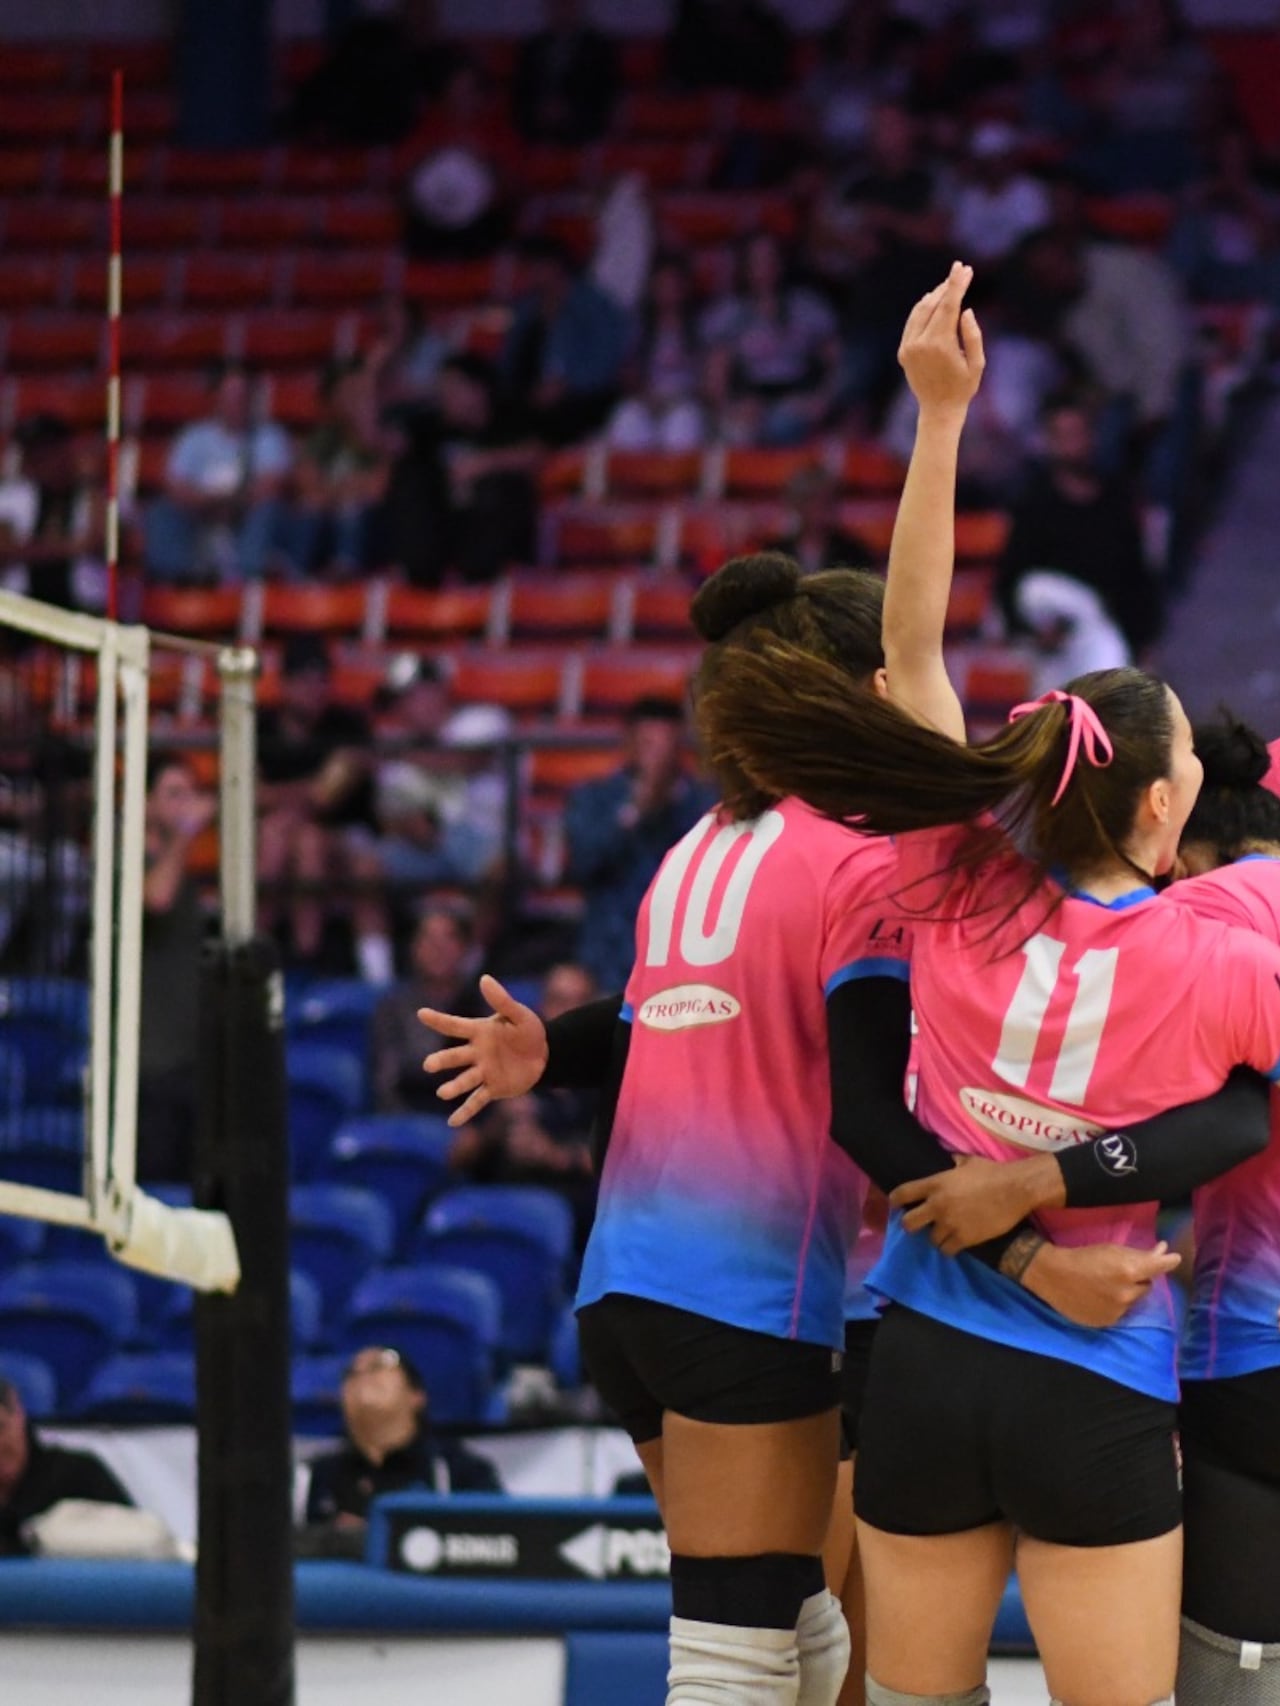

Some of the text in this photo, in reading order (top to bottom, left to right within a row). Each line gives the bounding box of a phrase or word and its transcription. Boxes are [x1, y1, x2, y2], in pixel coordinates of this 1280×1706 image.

[645, 809, 785, 967] 10
[645, 1000, 733, 1019] TROPIGAS
[991, 933, 1119, 1106] 11
